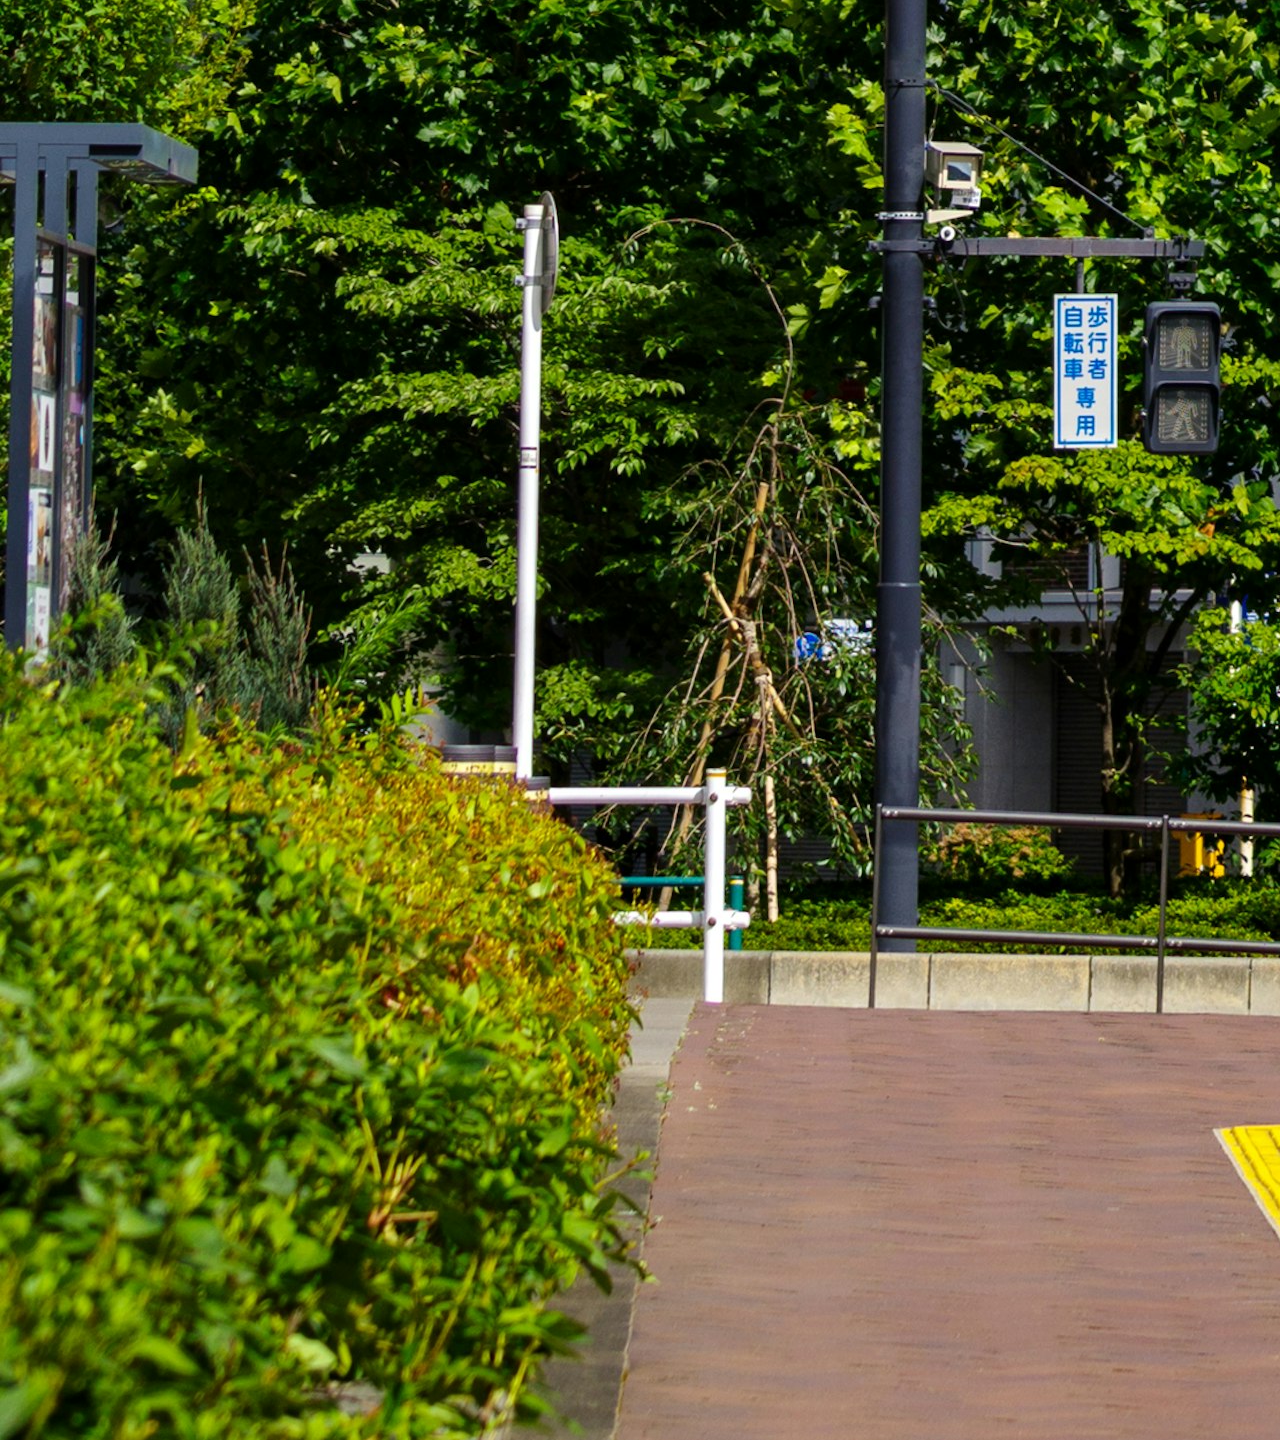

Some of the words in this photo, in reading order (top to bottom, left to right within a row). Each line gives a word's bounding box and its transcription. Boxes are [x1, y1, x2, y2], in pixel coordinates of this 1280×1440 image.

[1063, 306, 1084, 381] 自転車
[1087, 306, 1108, 381] 歩行者
[1075, 387, 1096, 437] 専用
